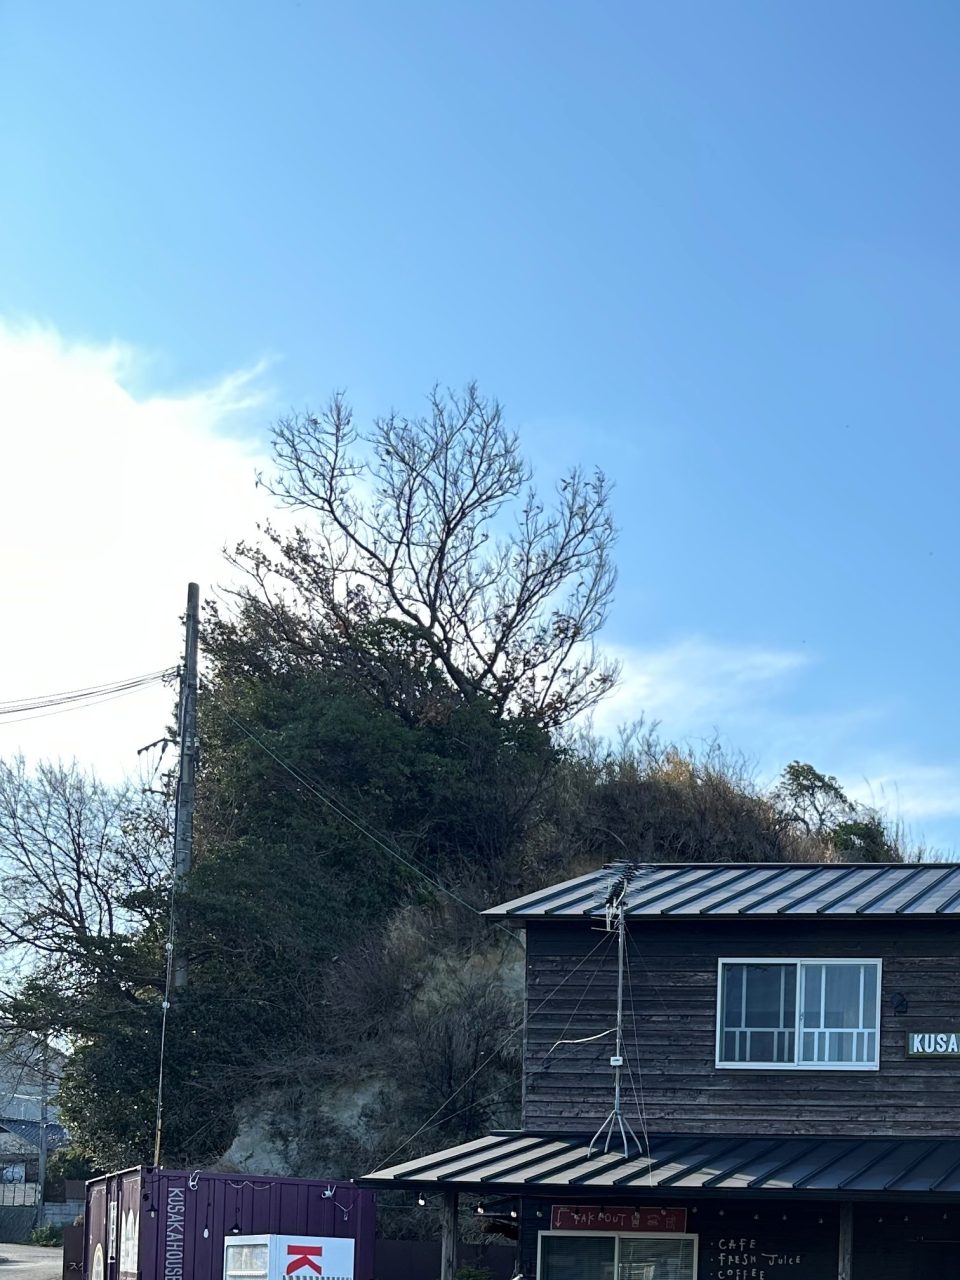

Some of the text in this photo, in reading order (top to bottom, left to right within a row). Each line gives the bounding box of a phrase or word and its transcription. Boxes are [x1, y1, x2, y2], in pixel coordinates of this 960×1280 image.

[718, 1239, 756, 1251] CAFE
[286, 1244, 323, 1276] K
[718, 1252, 757, 1266] FRESH
[717, 1268, 765, 1280] COFFEE
